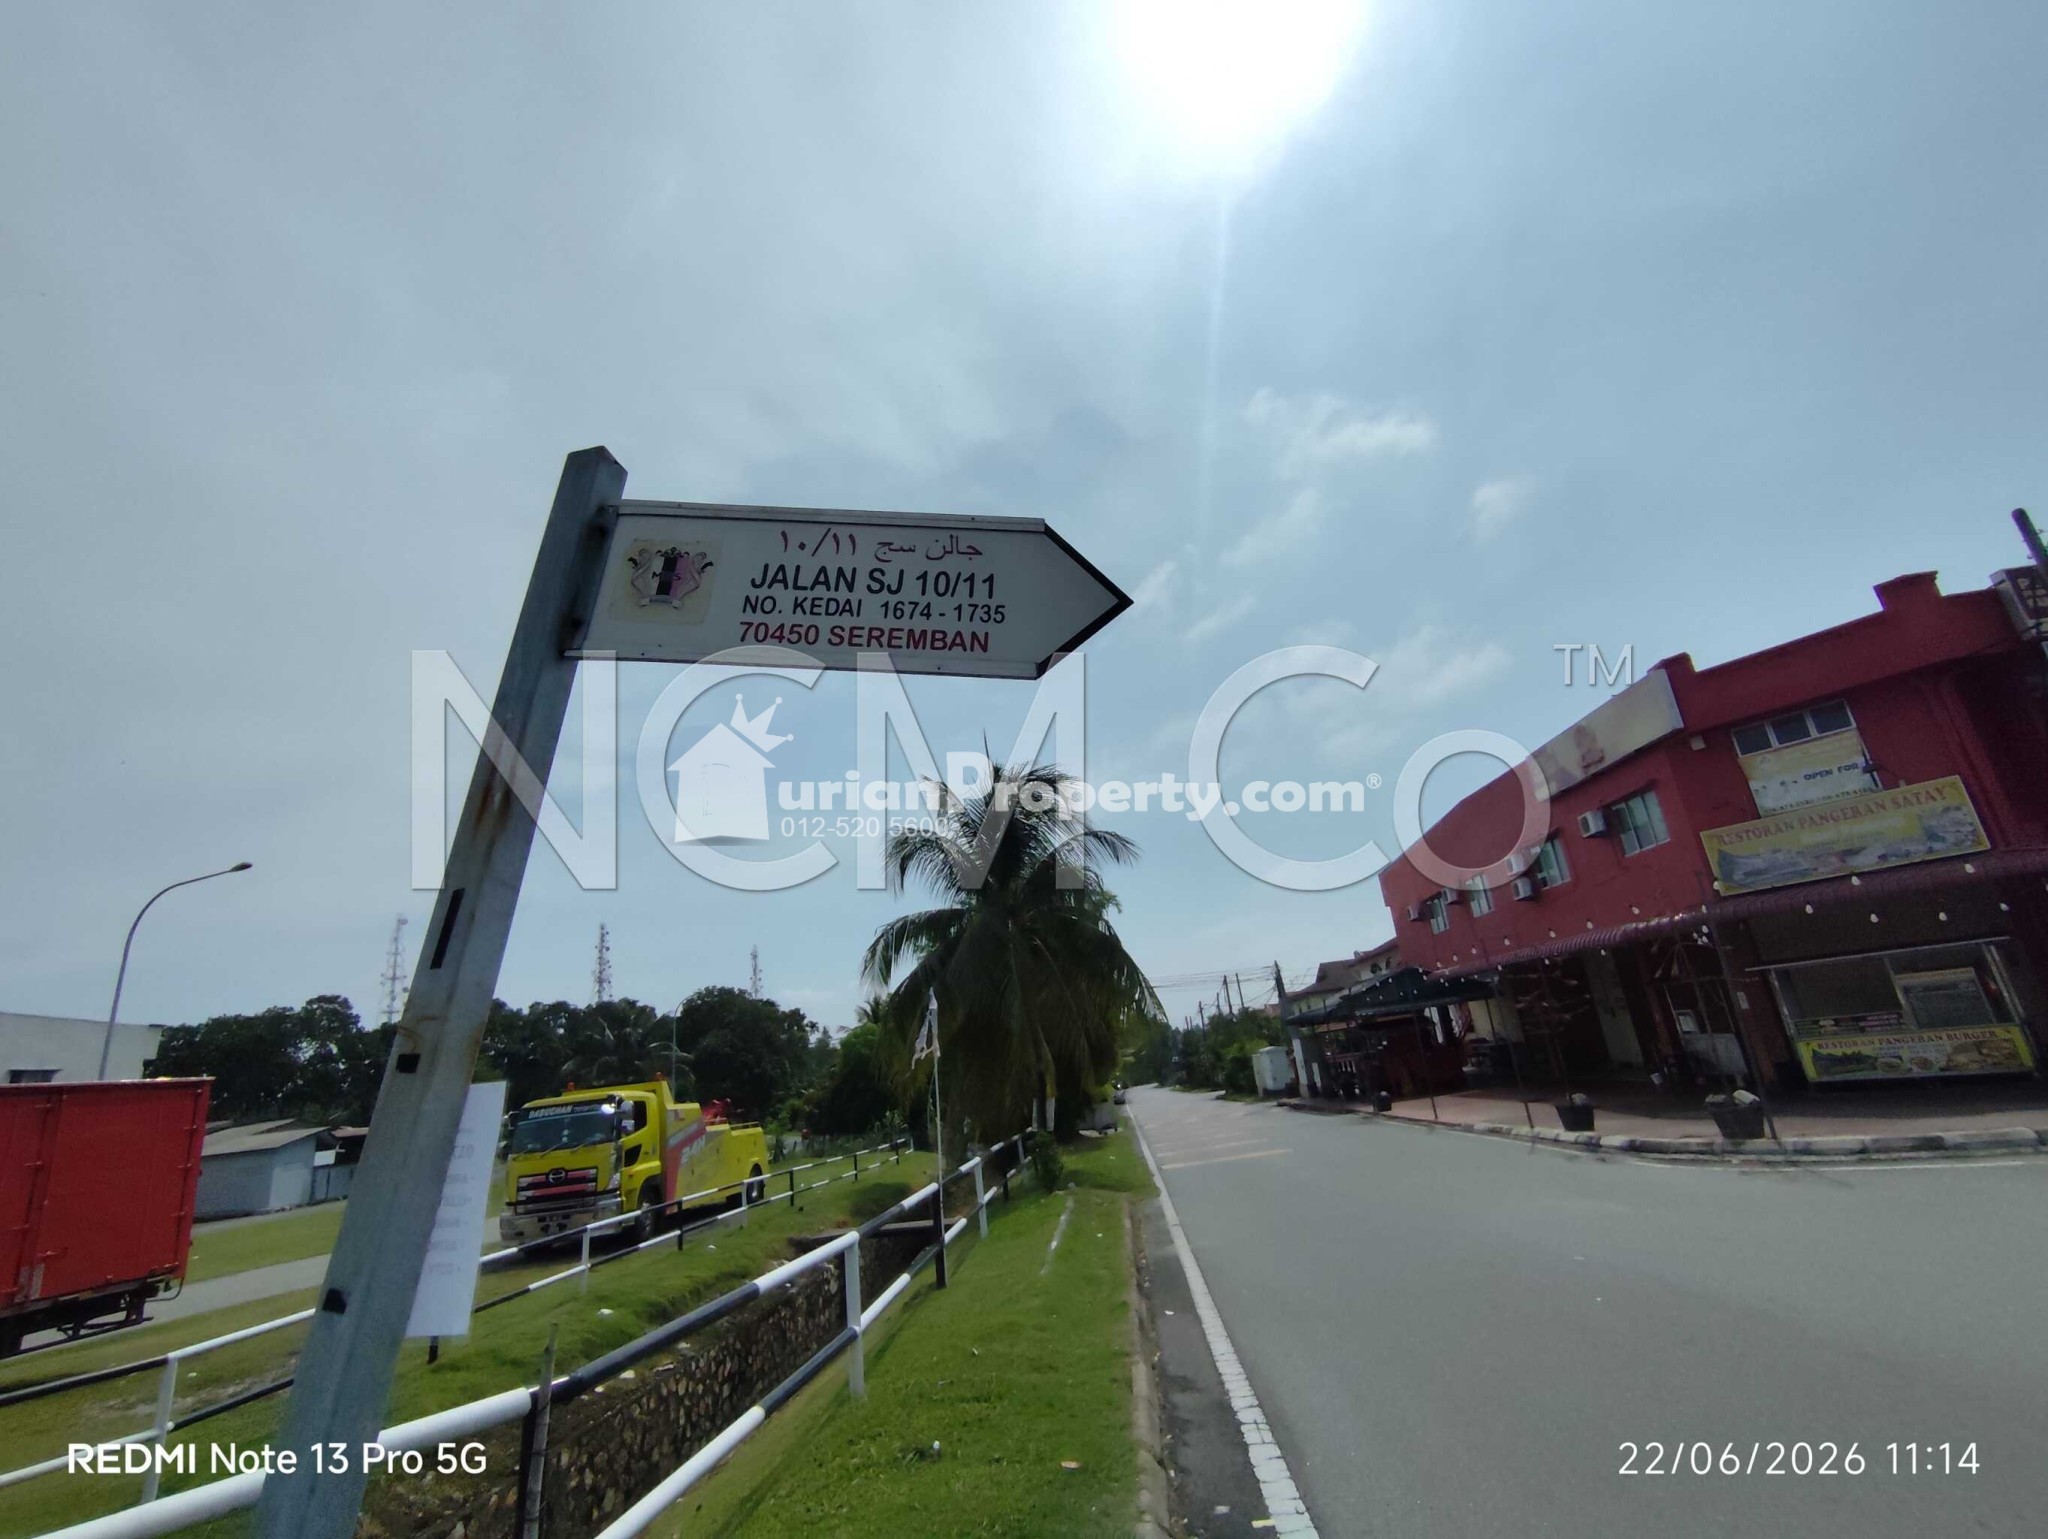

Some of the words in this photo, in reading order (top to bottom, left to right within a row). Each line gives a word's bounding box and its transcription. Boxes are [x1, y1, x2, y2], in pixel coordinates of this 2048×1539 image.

[750, 563, 856, 593] JALAN
[865, 567, 904, 596] SJ
[915, 570, 996, 600] 10/11
[742, 596, 781, 616] NO.
[793, 597, 862, 618] KEDAI
[739, 621, 820, 646] 70450
[827, 625, 989, 653] SEREMBAN
[1803, 767, 1834, 782] OPEN
[1716, 814, 1795, 846] RESTORAN
[1799, 800, 1889, 830] PANGERAN
[1892, 786, 1948, 809] SATAY
[1947, 1030, 1998, 1042] BURGER
